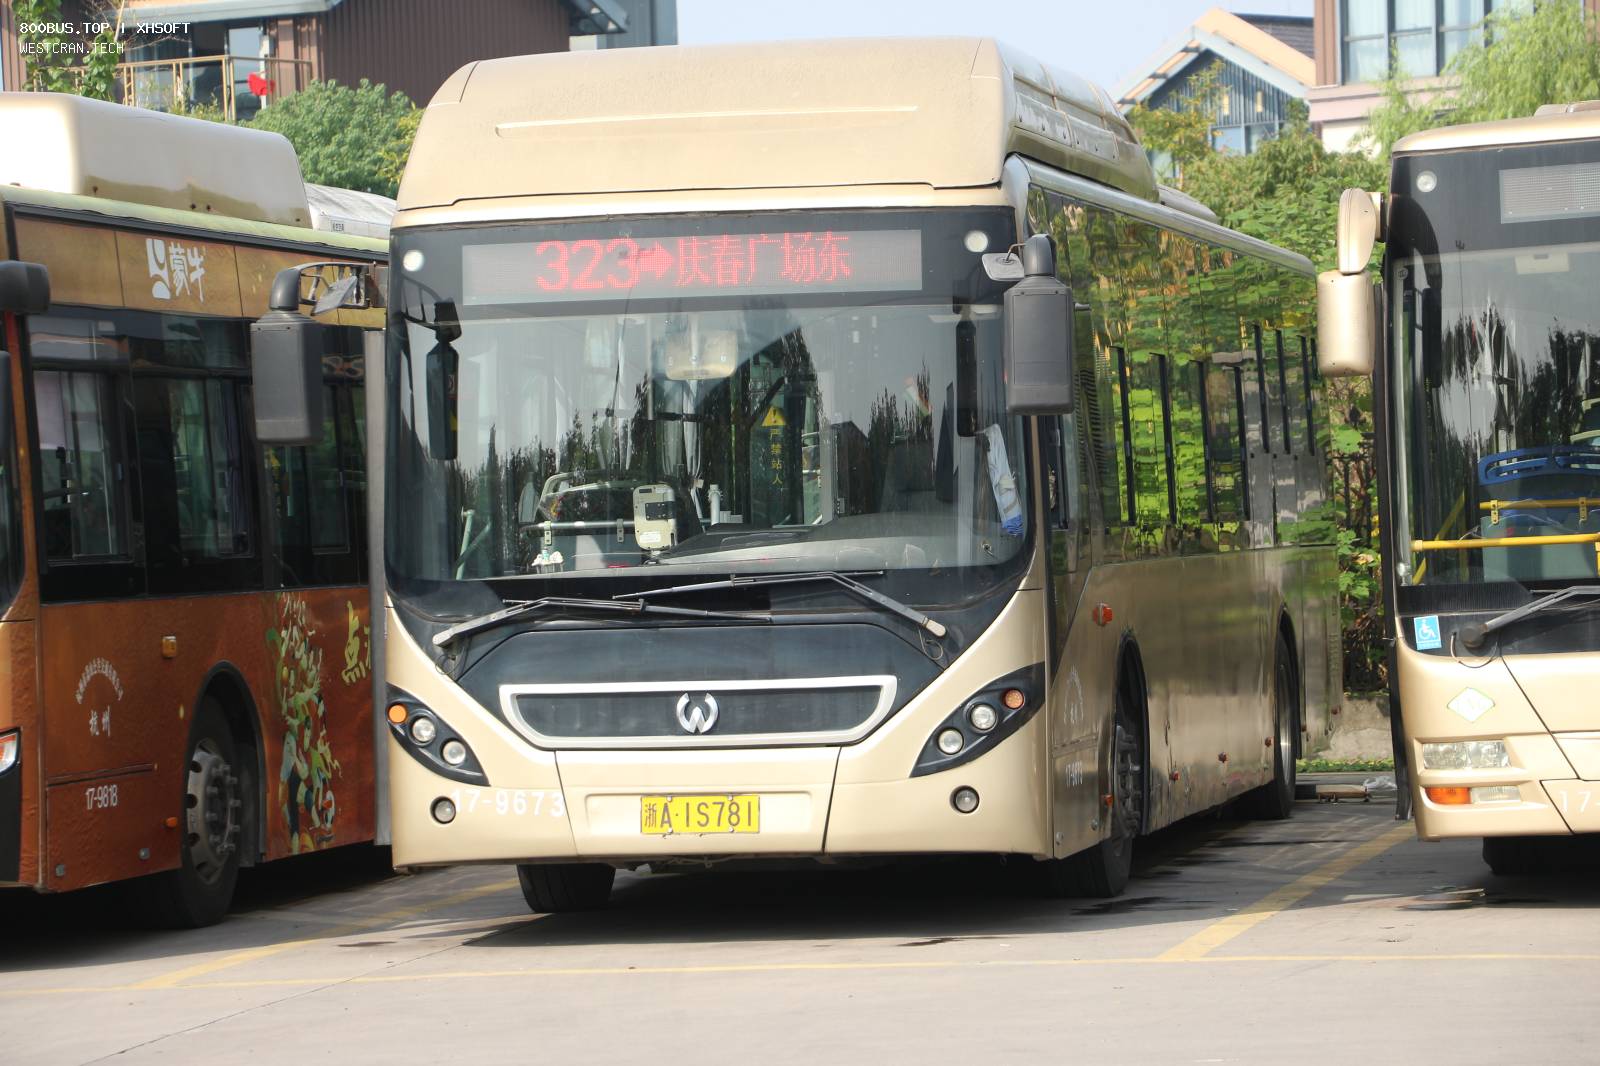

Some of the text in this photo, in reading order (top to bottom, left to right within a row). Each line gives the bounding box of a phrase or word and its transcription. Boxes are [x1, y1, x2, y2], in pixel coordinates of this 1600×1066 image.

[169, 241, 206, 303] 蒙牛
[535, 231, 851, 290] 323 庆春广场东
[769, 428, 782, 485] 严禁站人
[85, 784, 118, 810] 17-9818
[450, 788, 565, 817] 17-9673
